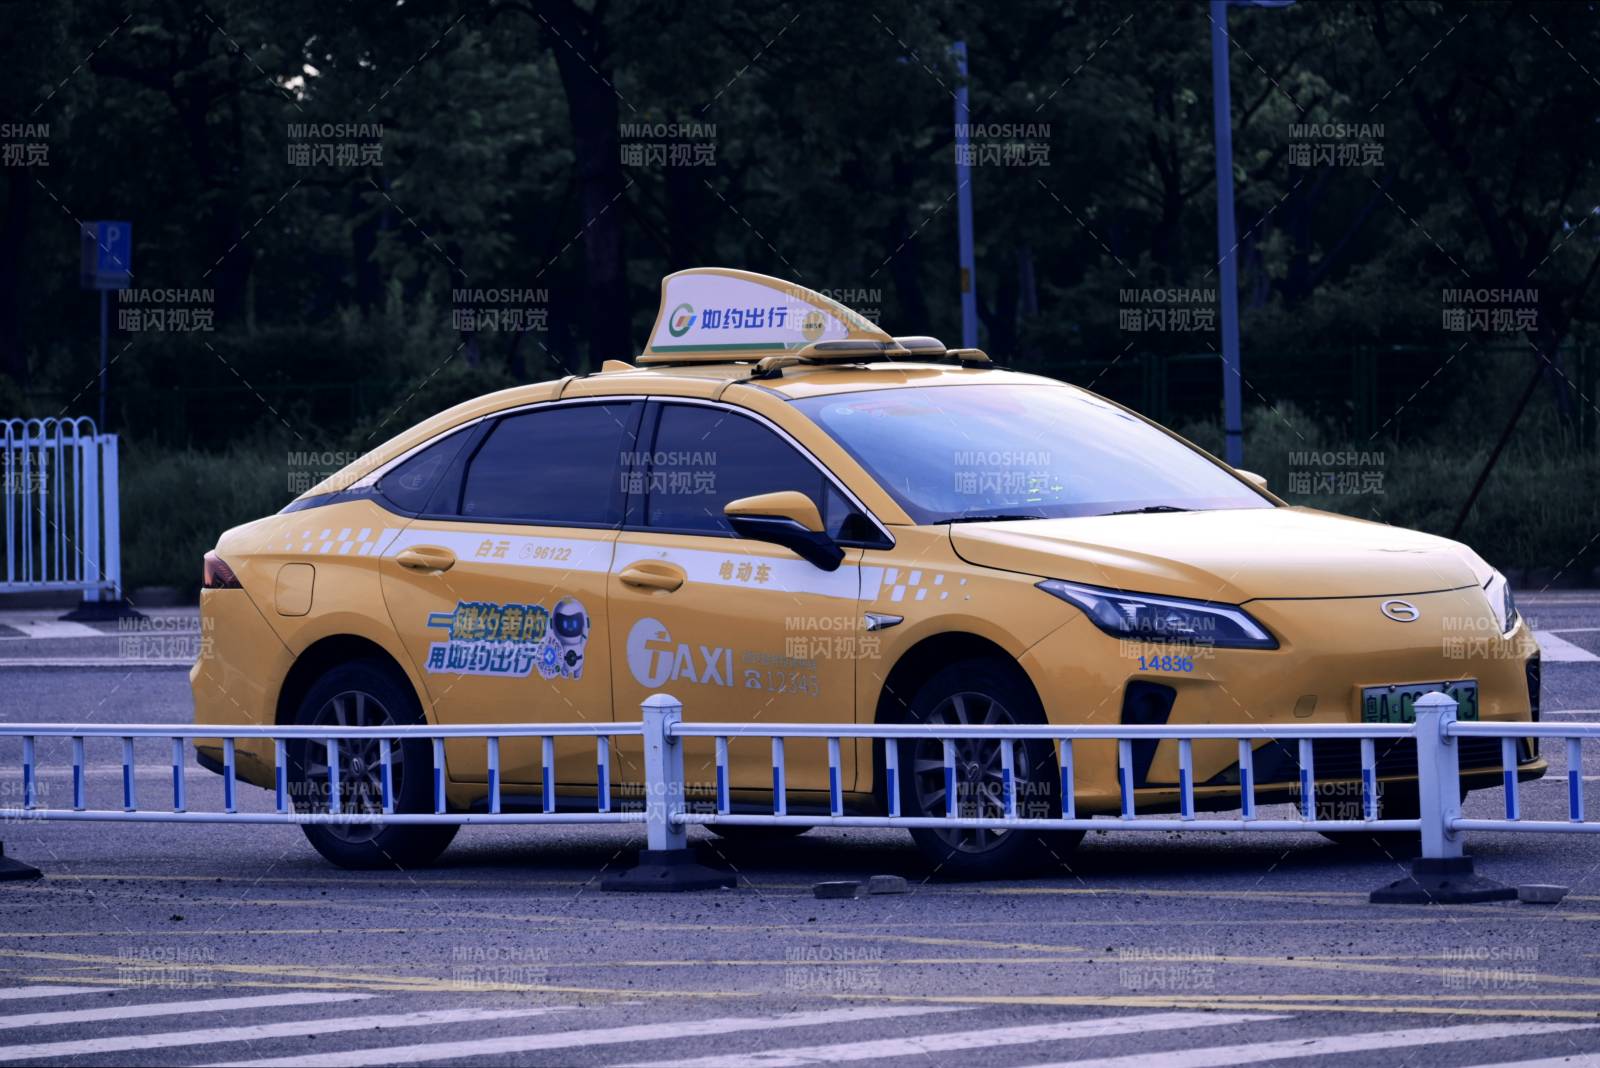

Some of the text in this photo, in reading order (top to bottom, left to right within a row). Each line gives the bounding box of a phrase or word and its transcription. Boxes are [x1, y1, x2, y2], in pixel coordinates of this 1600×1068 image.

[701, 307, 788, 329] 如约出行
[474, 539, 572, 561] 白云 96122
[719, 560, 772, 583] 电动车
[428, 643, 537, 674] 用如约出行
[640, 633, 735, 687] TAXI
[1137, 655, 1195, 672] 14836
